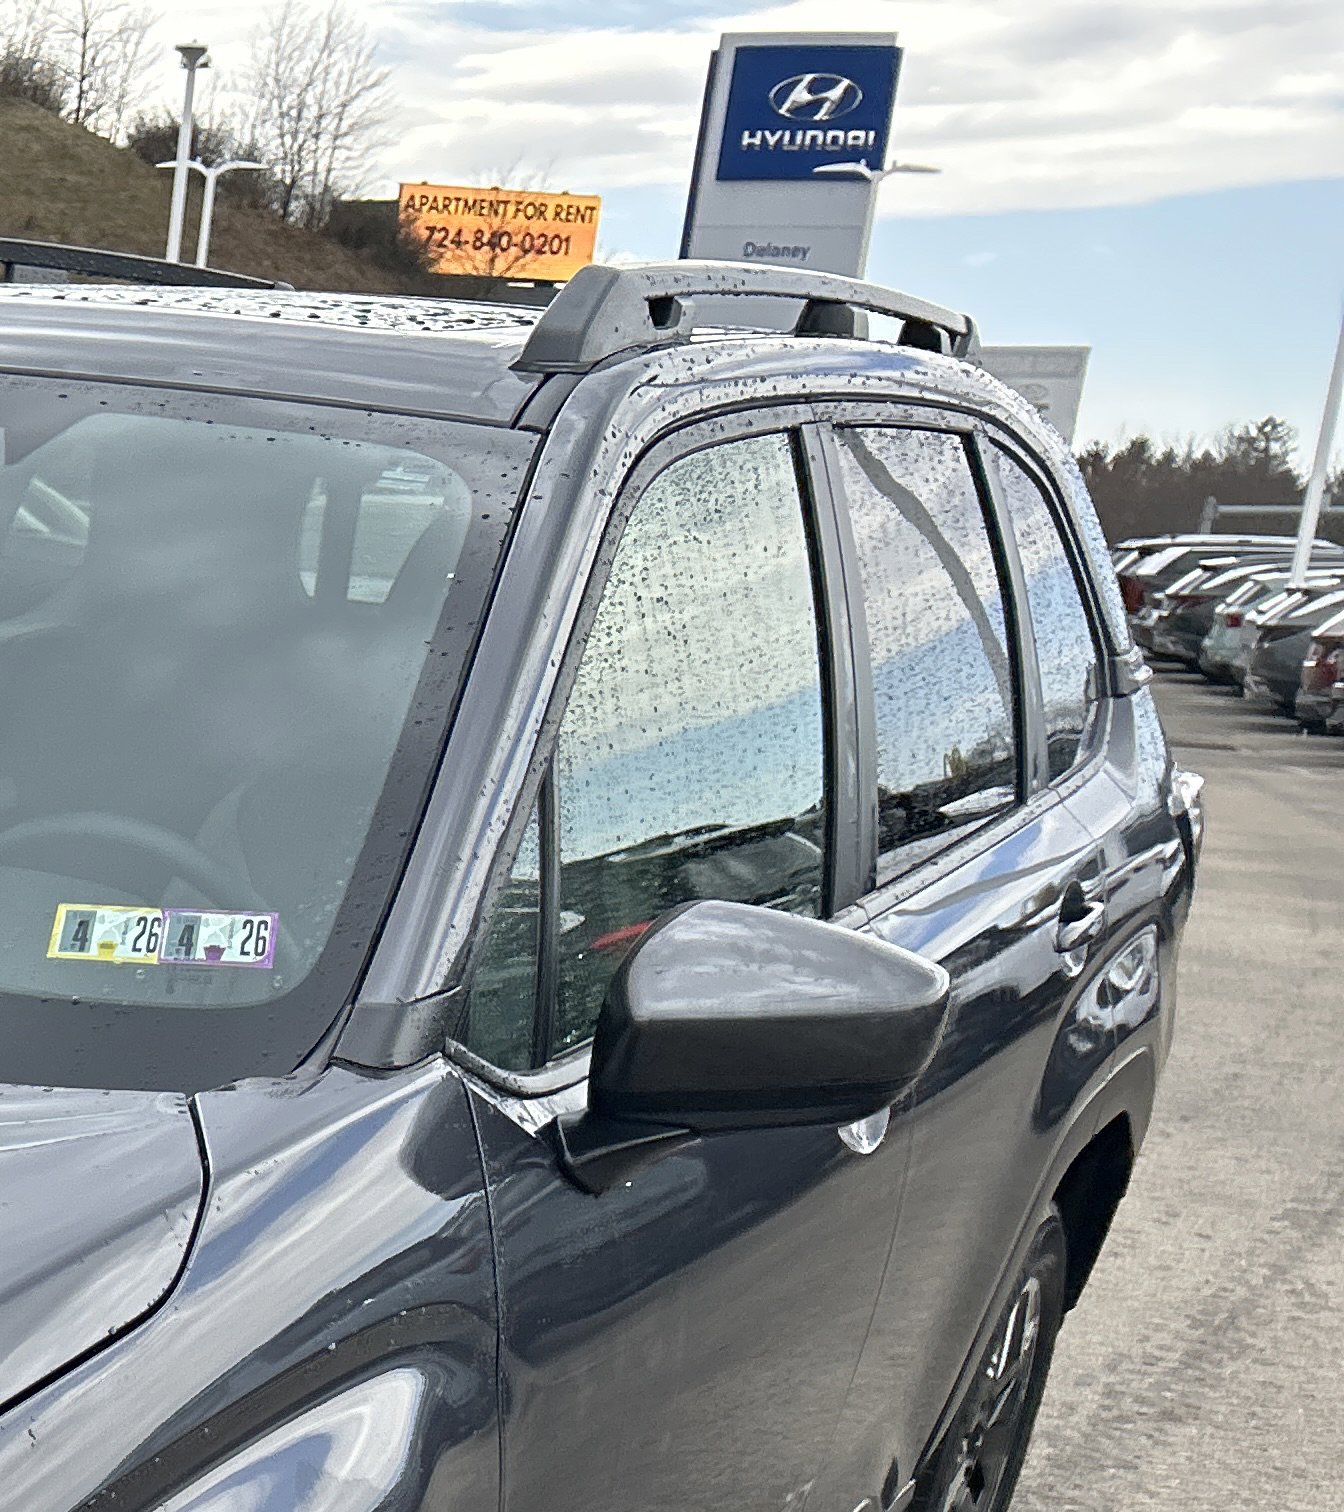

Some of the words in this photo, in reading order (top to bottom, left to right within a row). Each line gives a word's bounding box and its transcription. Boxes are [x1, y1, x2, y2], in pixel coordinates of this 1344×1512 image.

[741, 129, 876, 150] HYUNDAI
[404, 194, 511, 219] APARTMENT
[512, 201, 548, 222] FOR
[552, 203, 597, 224] RENT
[72, 919, 90, 952] 4
[131, 916, 162, 953] 26
[177, 924, 195, 957] 4
[240, 919, 269, 956] 26
